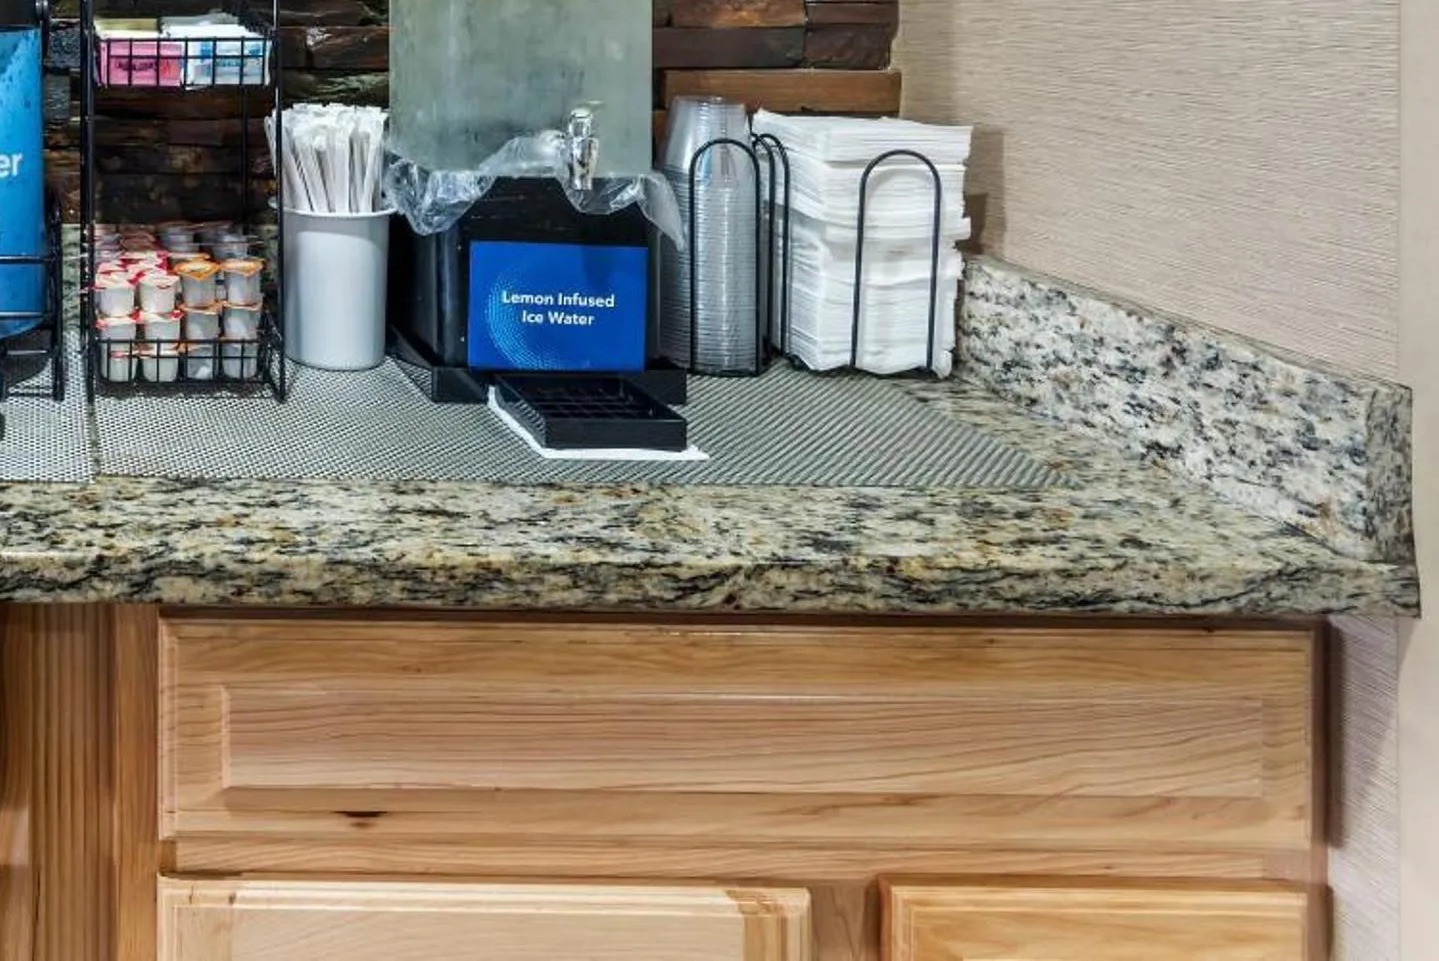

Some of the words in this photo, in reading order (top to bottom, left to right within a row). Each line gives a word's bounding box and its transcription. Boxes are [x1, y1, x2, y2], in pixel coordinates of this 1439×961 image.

[502, 290, 553, 305] Lemon
[558, 292, 615, 308] Infused
[522, 310, 543, 323] Ice
[548, 311, 594, 326] Water
